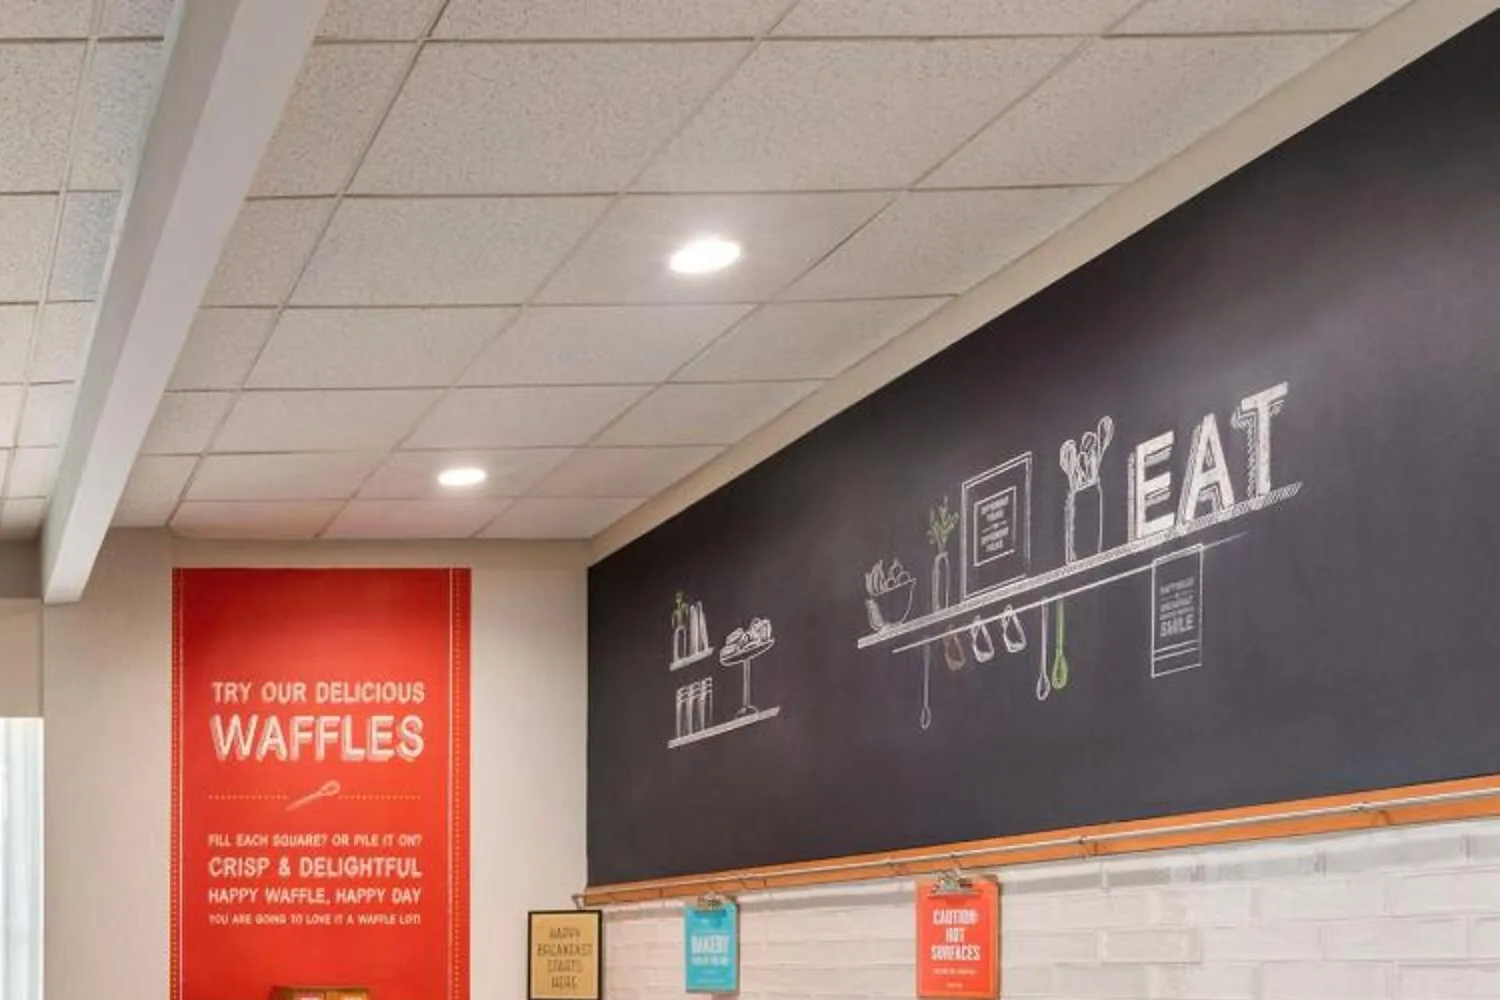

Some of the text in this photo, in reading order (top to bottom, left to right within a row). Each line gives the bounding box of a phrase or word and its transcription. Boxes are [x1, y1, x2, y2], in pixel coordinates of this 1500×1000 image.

[1127, 382, 1288, 541] EAT
[212, 682, 425, 703] TRY OUR DELICIOUS
[209, 714, 424, 762] WAFFLES
[208, 833, 231, 847] FILL
[236, 833, 268, 847] EACH
[272, 833, 327, 848] SQUARE?
[331, 833, 349, 847] OR
[353, 833, 379, 847] PILE
[382, 833, 395, 847] IT
[209, 855, 422, 879] CRISP & DELIGHTFUL
[208, 887, 421, 905] HAPPY WAFFLE, HAPPY DAY
[209, 914, 229, 925] YOU
[231, 914, 252, 925] ARE
[255, 914, 287, 925] GOING
[291, 914, 303, 925] TO
[306, 914, 332, 925] LOVE
[346, 914, 354, 925] A
[358, 914, 397, 925] WAFFLE
[691, 935, 730, 954] BAKERY
[946, 928, 965, 943] HOT
[537, 943, 593, 957] BREAKFAST
[931, 945, 981, 961] SURFACES
